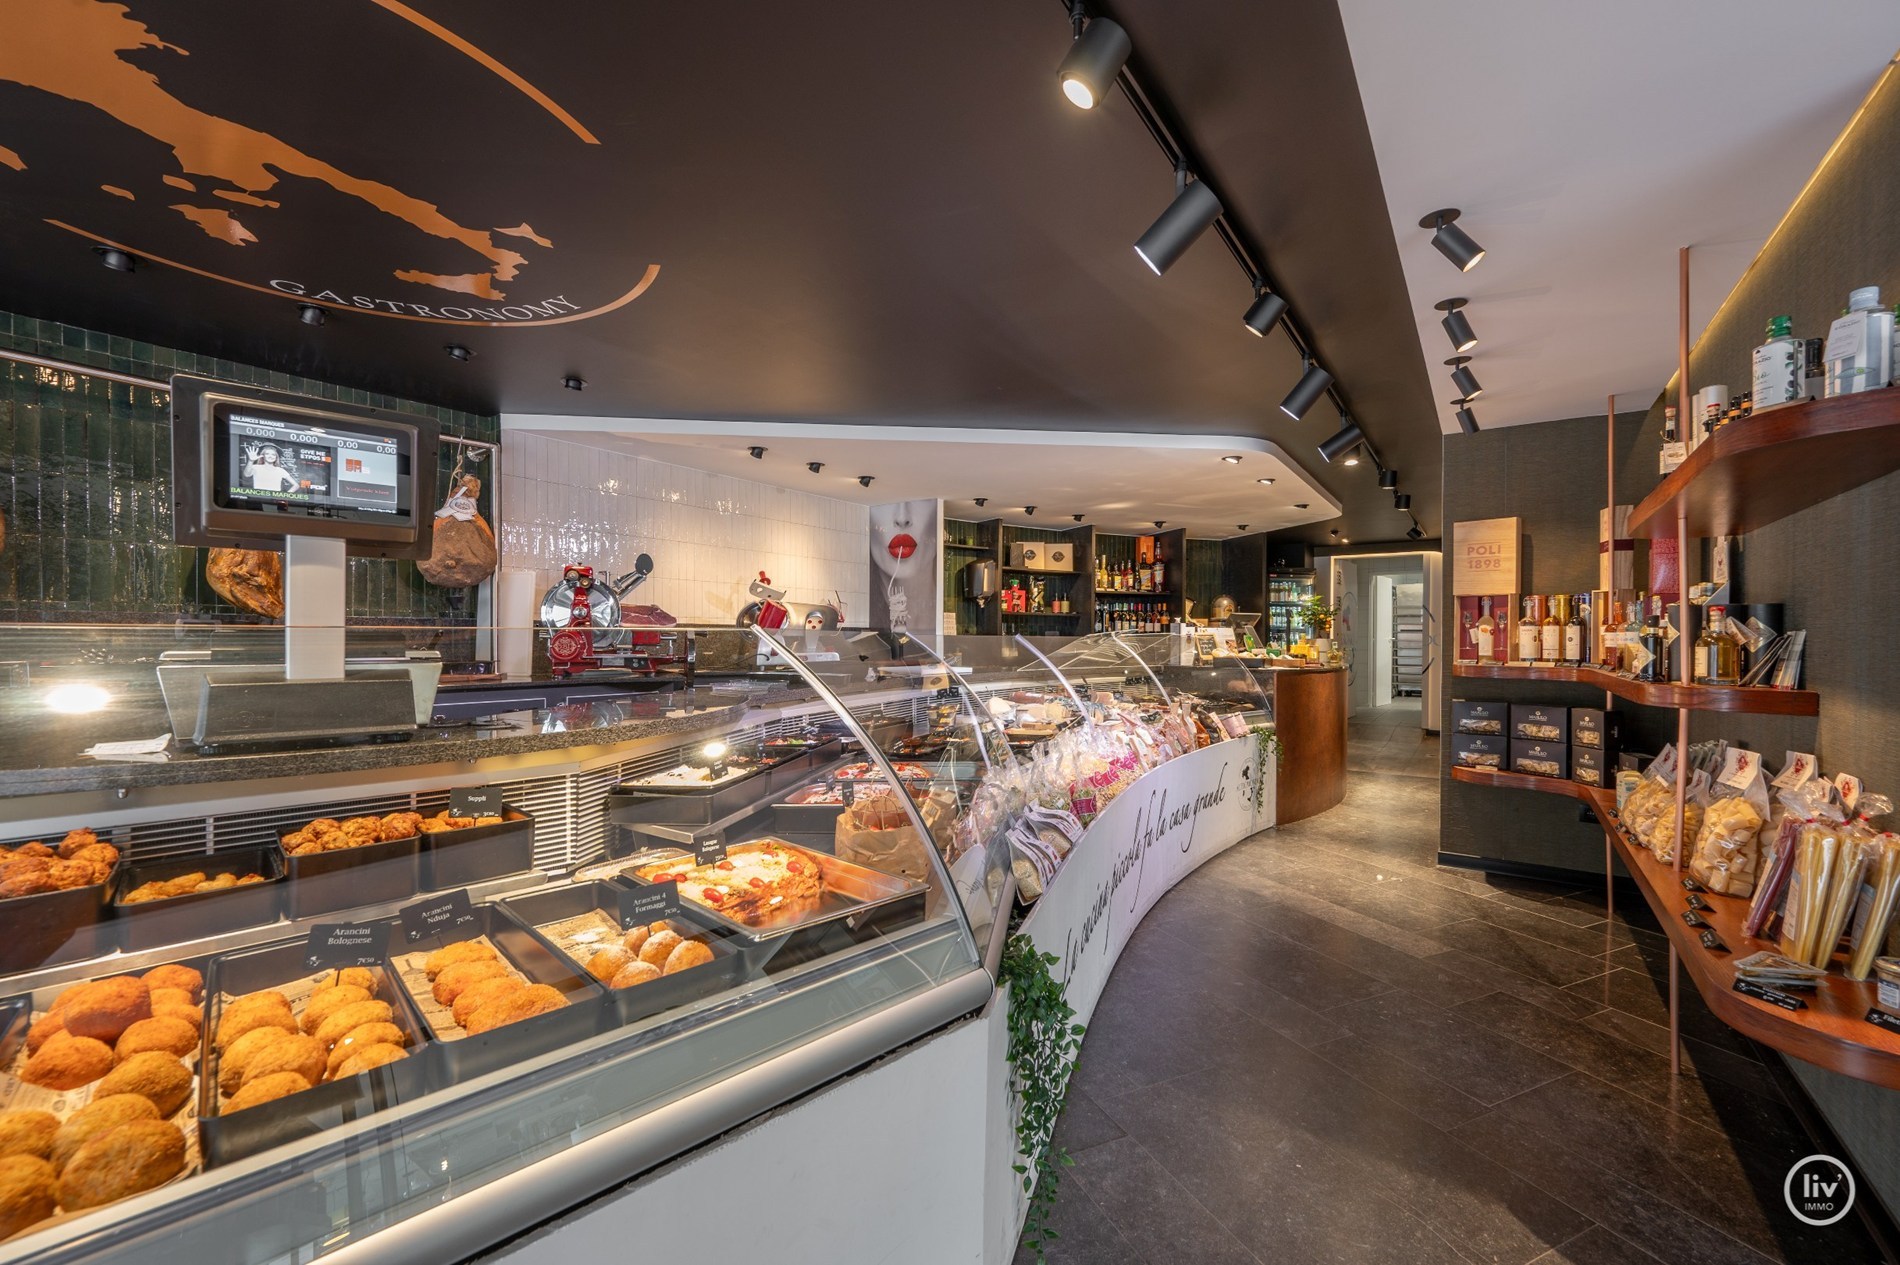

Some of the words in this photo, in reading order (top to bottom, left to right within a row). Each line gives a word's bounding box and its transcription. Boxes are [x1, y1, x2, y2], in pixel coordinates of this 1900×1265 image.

[269, 279, 581, 321] GASTRONOMY
[230, 415, 259, 424] BALANCES
[259, 419, 285, 428] MARQUES
[230, 487, 271, 496] BALANCES
[272, 491, 309, 500] MARQUES
[1467, 544, 1501, 556] POLI
[1467, 559, 1501, 569] 1898
[1156, 788, 1168, 841] la
[1169, 802, 1193, 831] casa
[1181, 762, 1228, 853] grande
[632, 894, 661, 906] Arancini
[421, 903, 453, 918] Arancini
[635, 901, 666, 913] Formaggi
[427, 912, 450, 924] Nduja
[333, 927, 371, 935] Arancini
[328, 937, 372, 945] Bolognese
